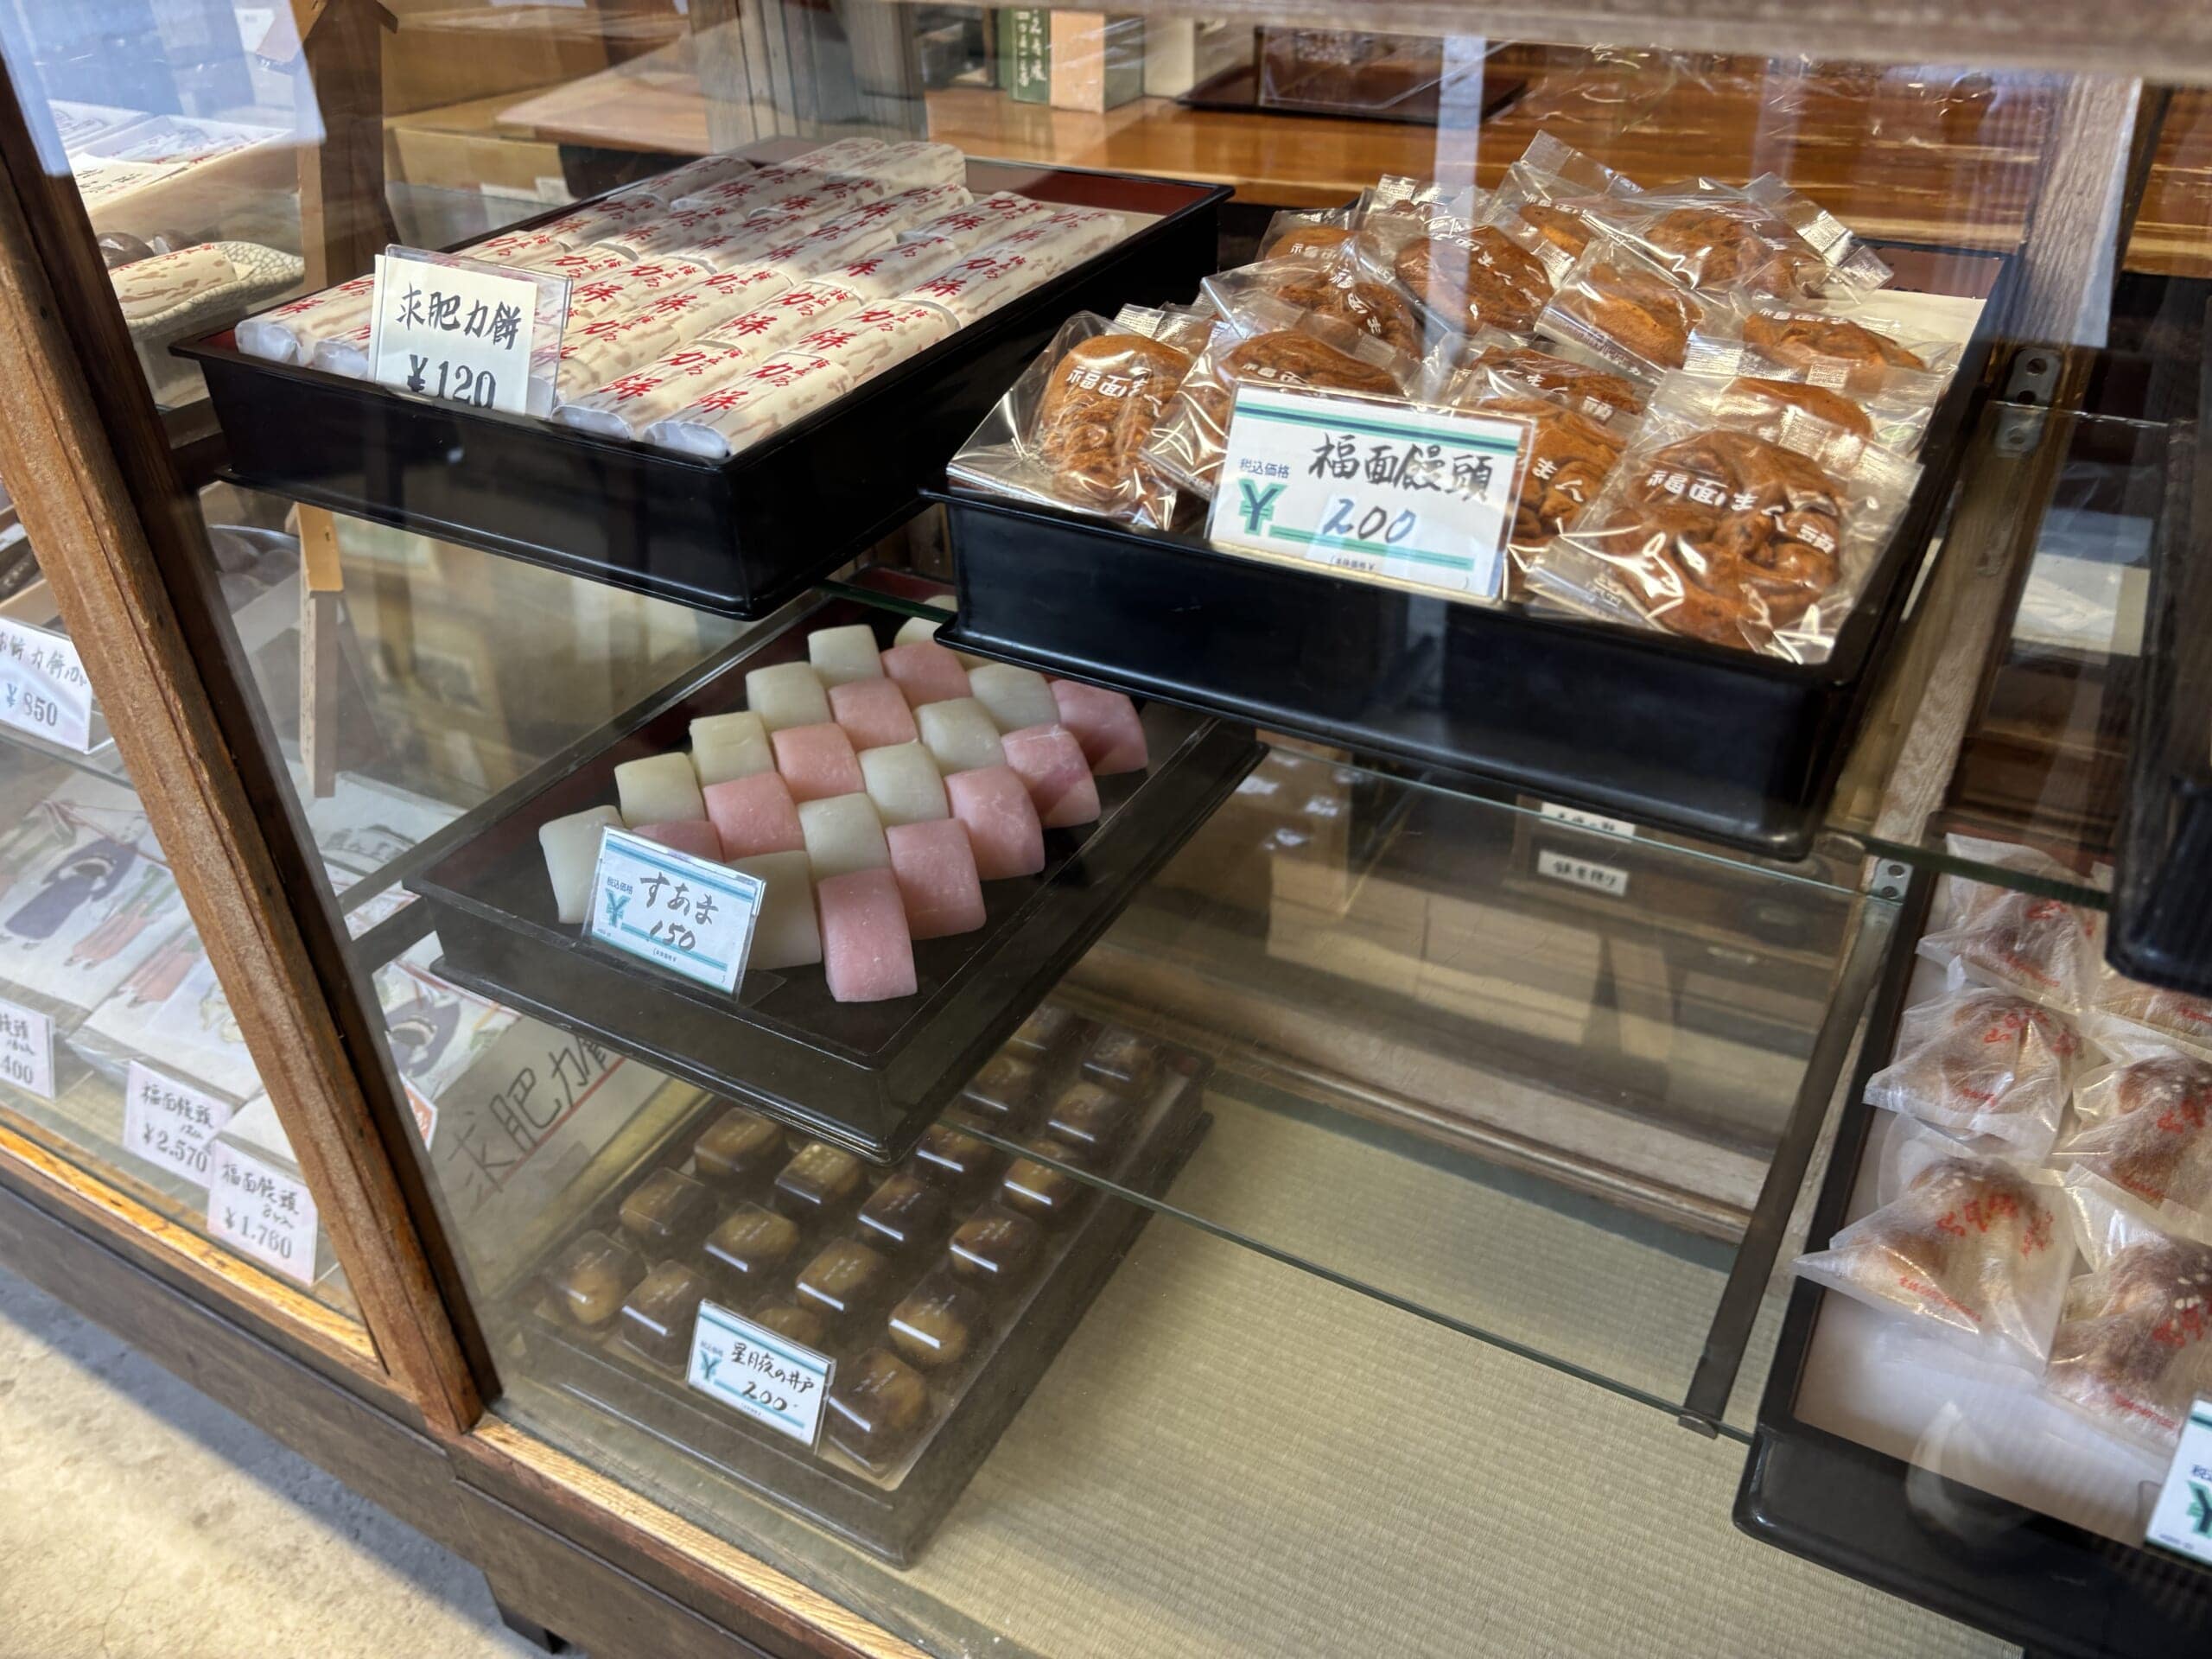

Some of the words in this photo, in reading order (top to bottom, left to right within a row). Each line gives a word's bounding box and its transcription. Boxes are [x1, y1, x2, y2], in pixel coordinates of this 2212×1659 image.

[396, 281, 522, 350] 求肥力餅
[1239, 458, 1290, 480] 税込価格
[1308, 431, 1495, 503] 福面饅頭
[1323, 498, 1417, 543] 200
[607, 877, 633, 895] 税込価格
[639, 872, 720, 925] すあま
[649, 919, 696, 950] 150
[741, 1381, 787, 1411] 200
